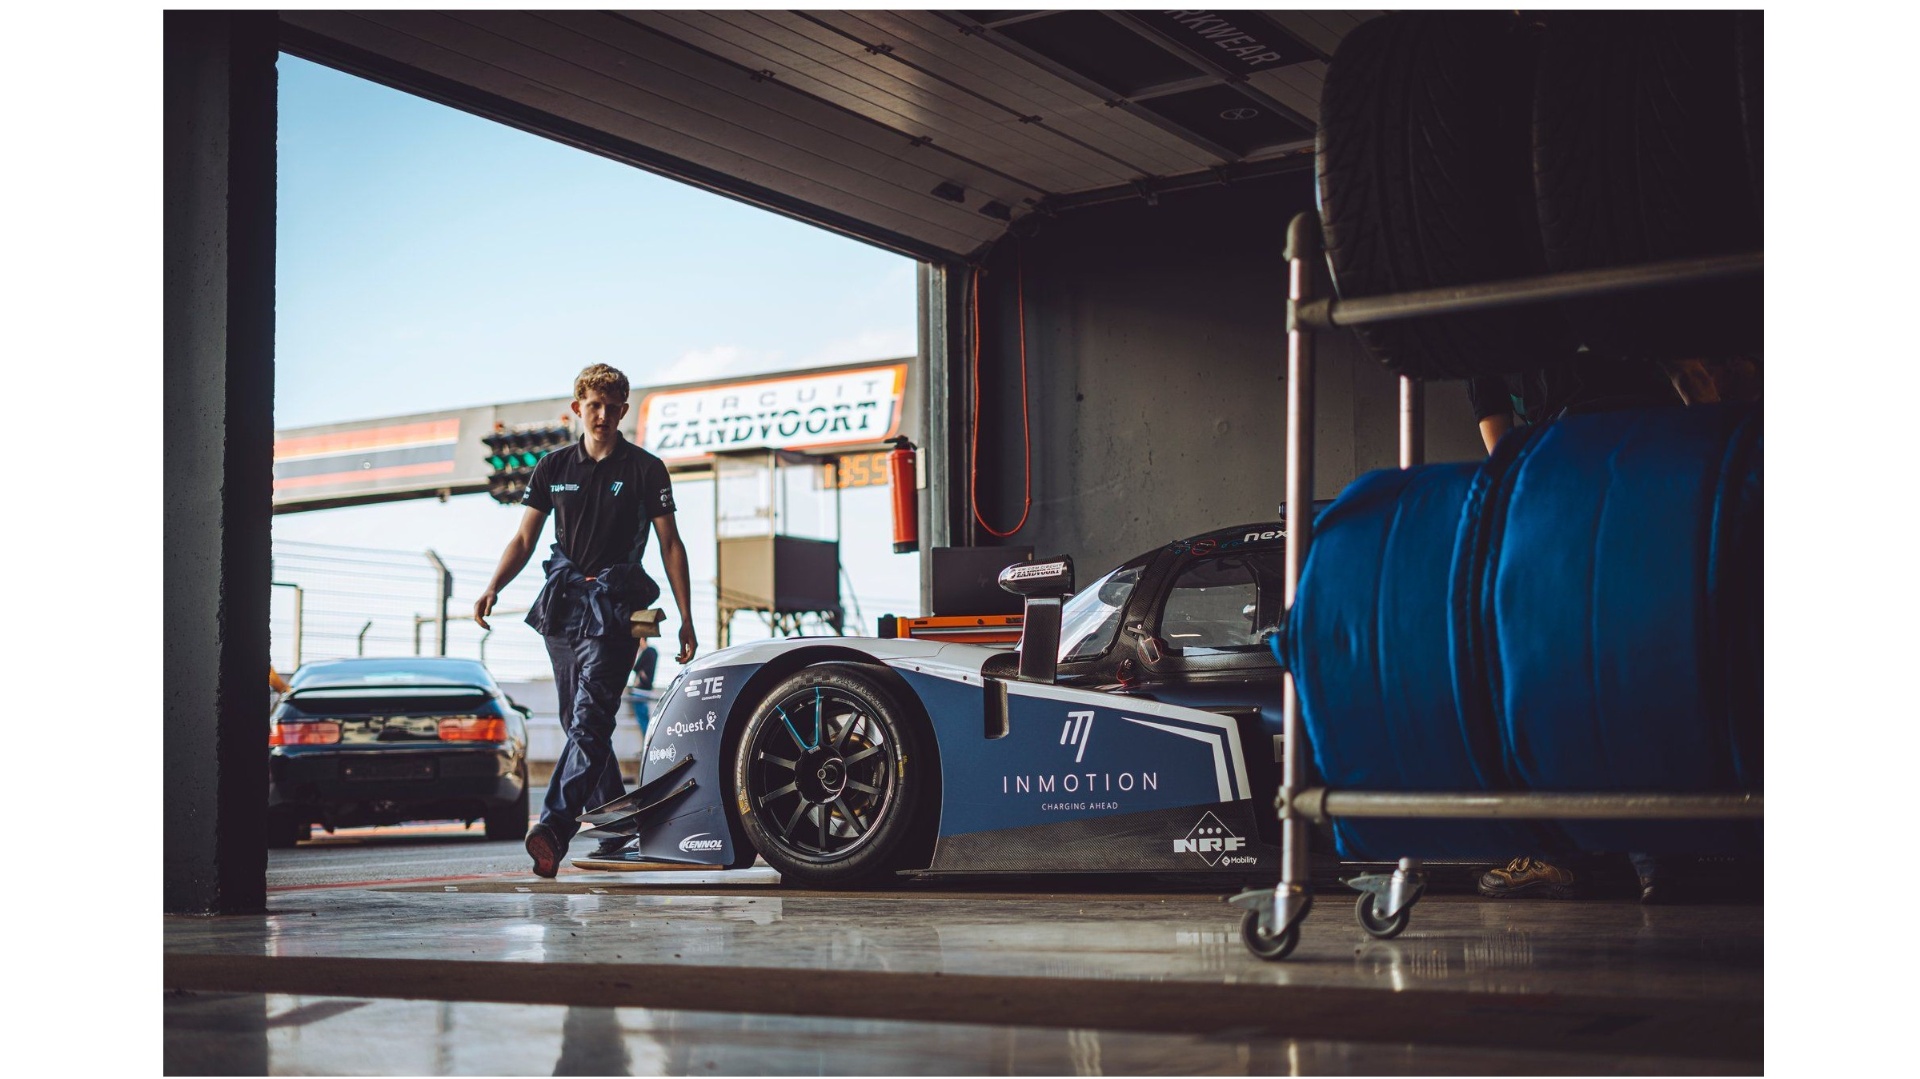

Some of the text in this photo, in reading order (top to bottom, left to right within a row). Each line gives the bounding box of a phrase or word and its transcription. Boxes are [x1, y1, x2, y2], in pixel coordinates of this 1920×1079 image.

[661, 380, 879, 417] CIRCUIT
[657, 401, 876, 450] ZANDVOORT
[703, 675, 724, 695] TE
[666, 718, 704, 737] e-Quest
[1003, 772, 1157, 794] INMOTION
[1041, 801, 1119, 811] CHARGING AHEAD
[682, 839, 723, 849] KENNOL
[1173, 837, 1246, 853] NRF
